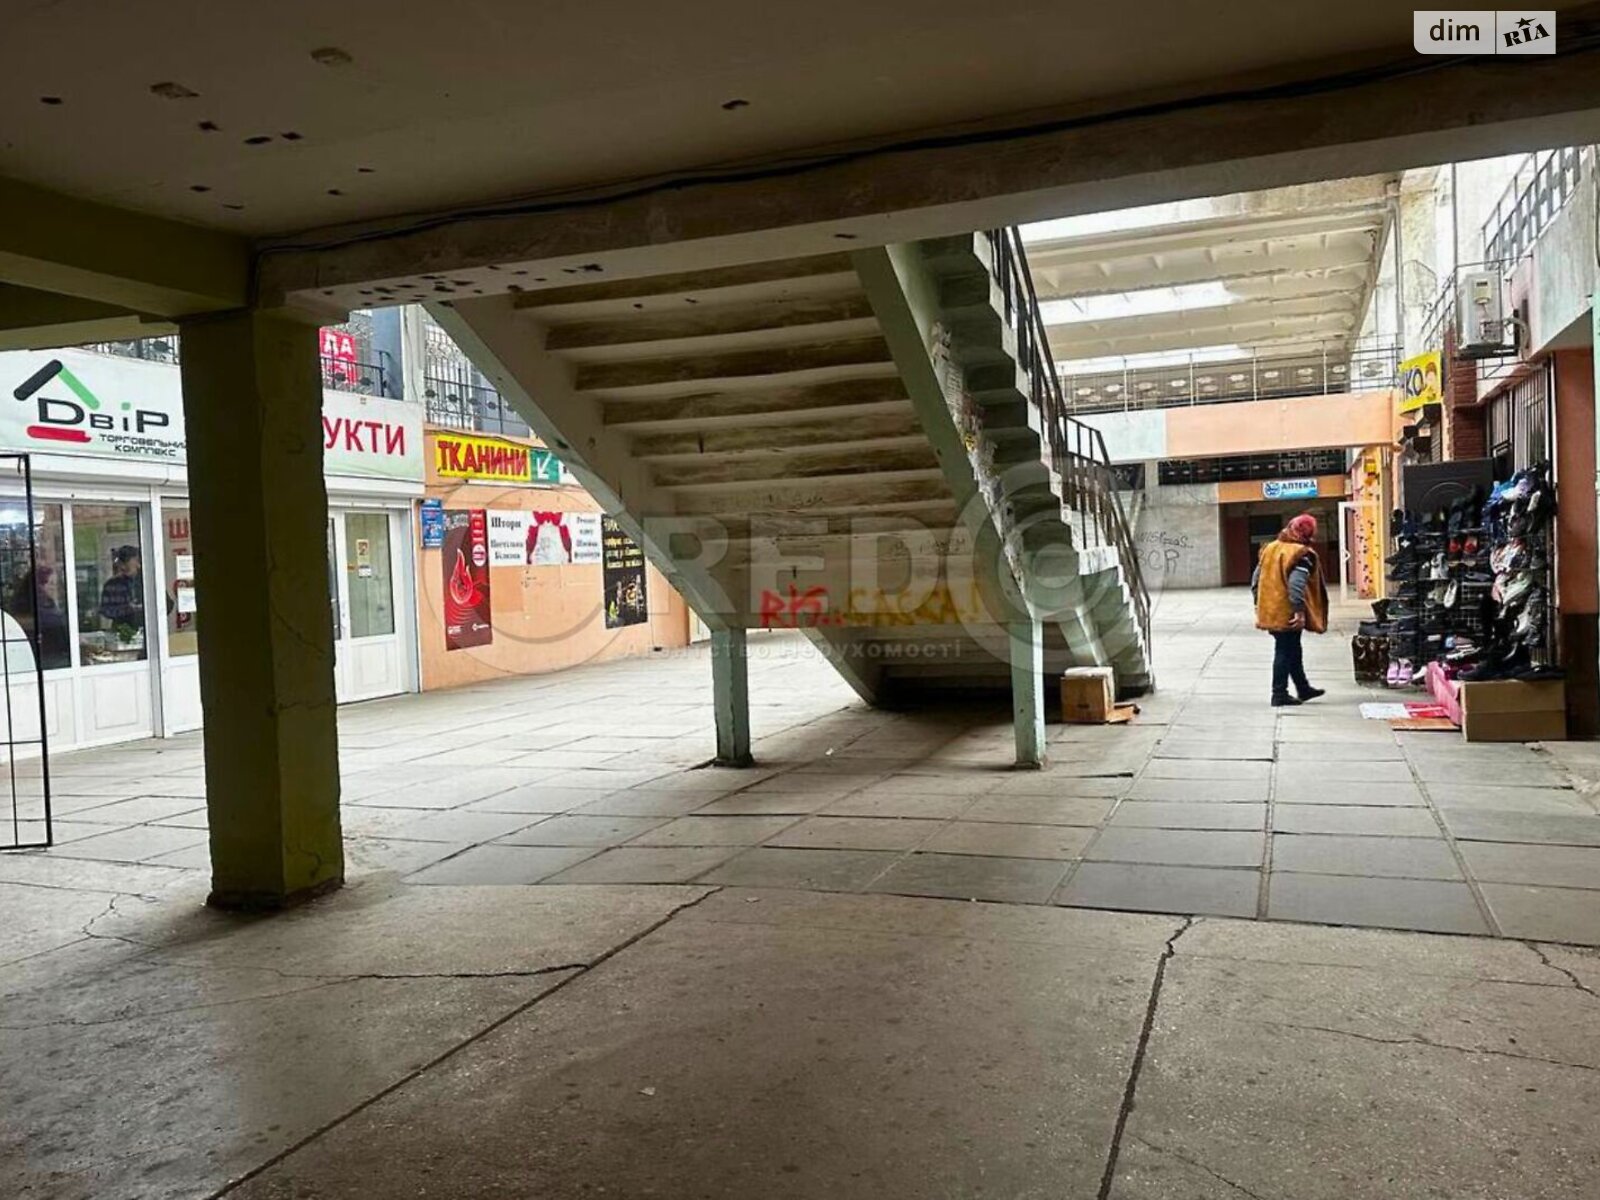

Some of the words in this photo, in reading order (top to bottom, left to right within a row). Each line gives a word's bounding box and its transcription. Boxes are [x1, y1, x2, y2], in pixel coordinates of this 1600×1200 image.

[99, 434, 187, 449] ТОРГОВЕЛЬНИ
[114, 445, 177, 457] КОМПЛЕКС
[437, 440, 529, 477] ТКАНИНИ
[1281, 481, 1316, 491] АПТЕКА
[491, 517, 521, 531] Штори
